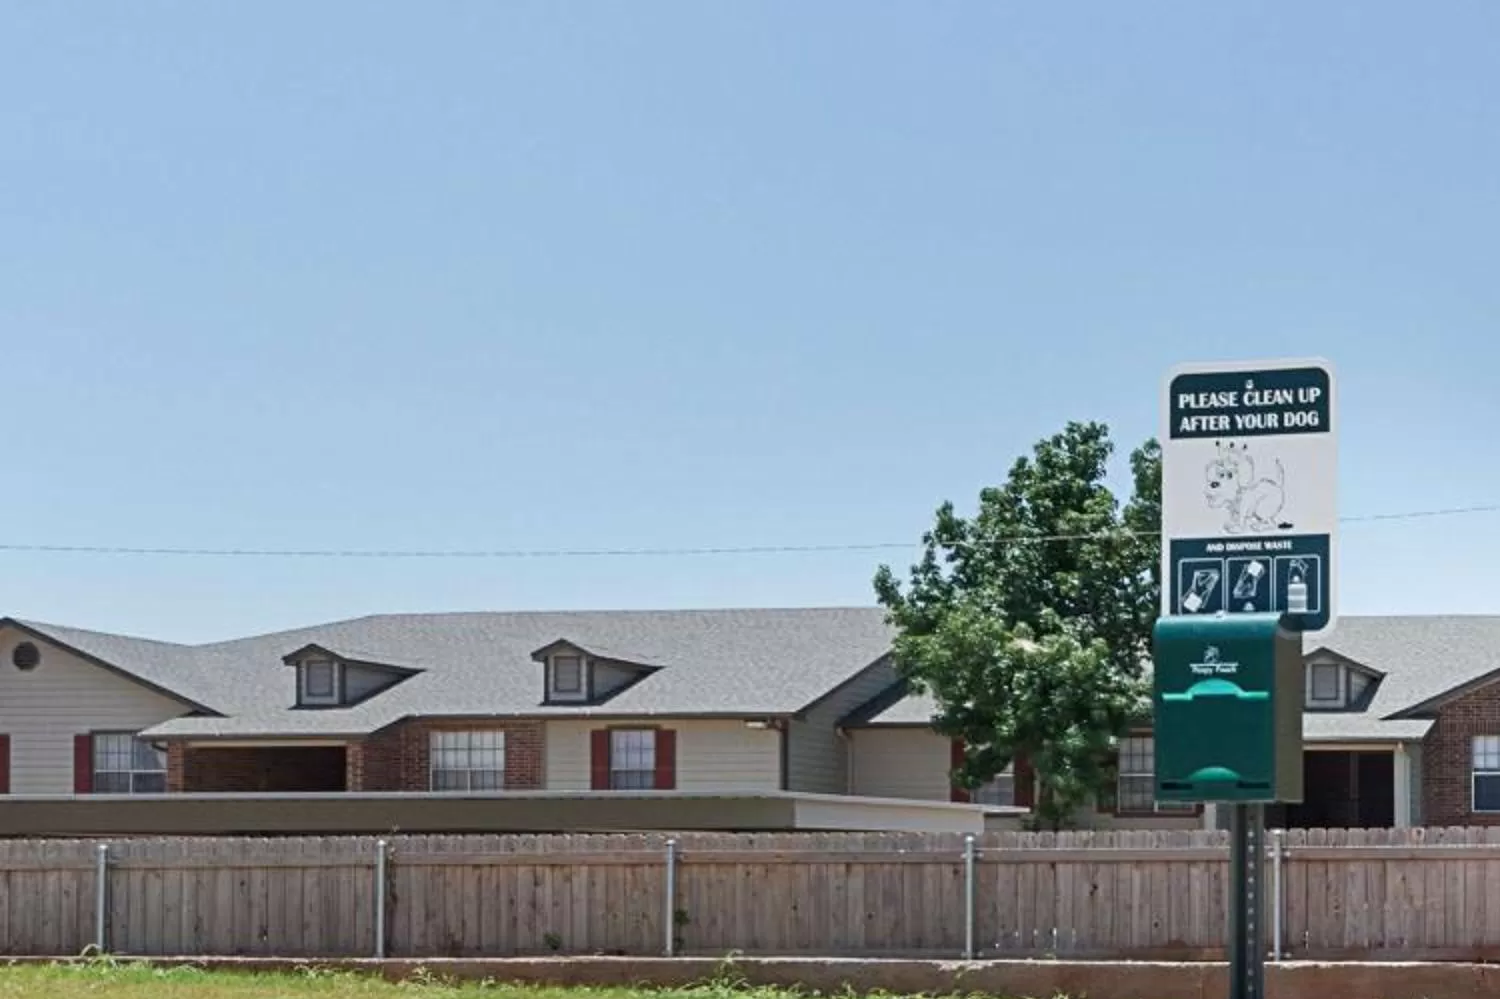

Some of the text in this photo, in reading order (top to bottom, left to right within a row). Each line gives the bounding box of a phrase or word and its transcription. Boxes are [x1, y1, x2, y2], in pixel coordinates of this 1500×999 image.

[1178, 387, 1321, 409] PLEASE CLEAN UP
[1180, 410, 1319, 432] AFTER YOUR DOG
